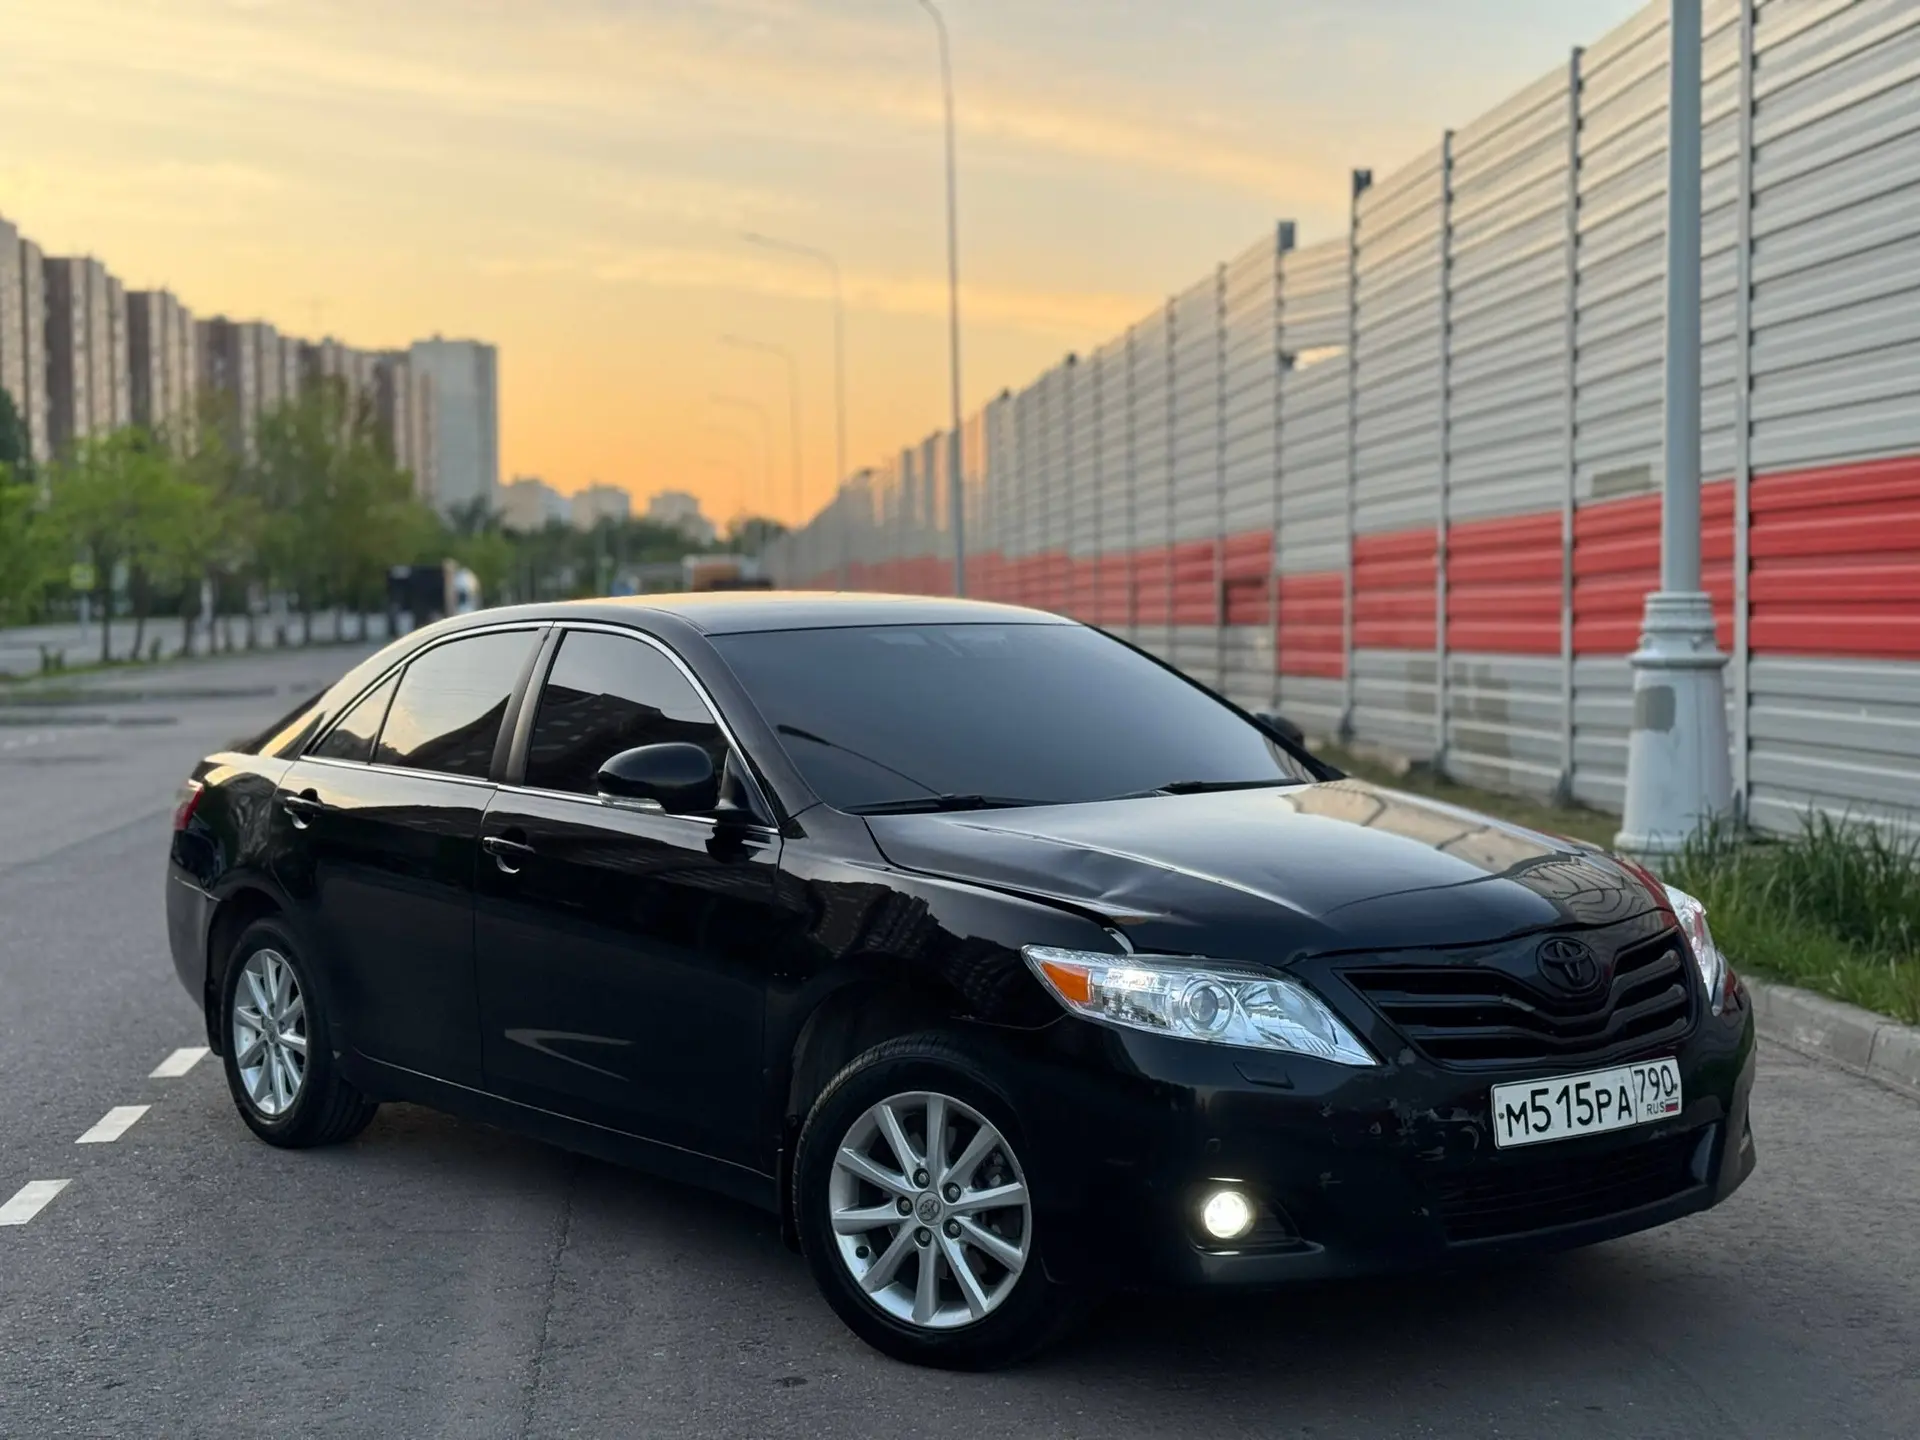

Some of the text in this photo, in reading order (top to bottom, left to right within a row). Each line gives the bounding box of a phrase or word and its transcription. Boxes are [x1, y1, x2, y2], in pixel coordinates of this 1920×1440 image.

[1505, 1065, 1674, 1137] М515РА 790
[1647, 1101, 1666, 1115] RUS
